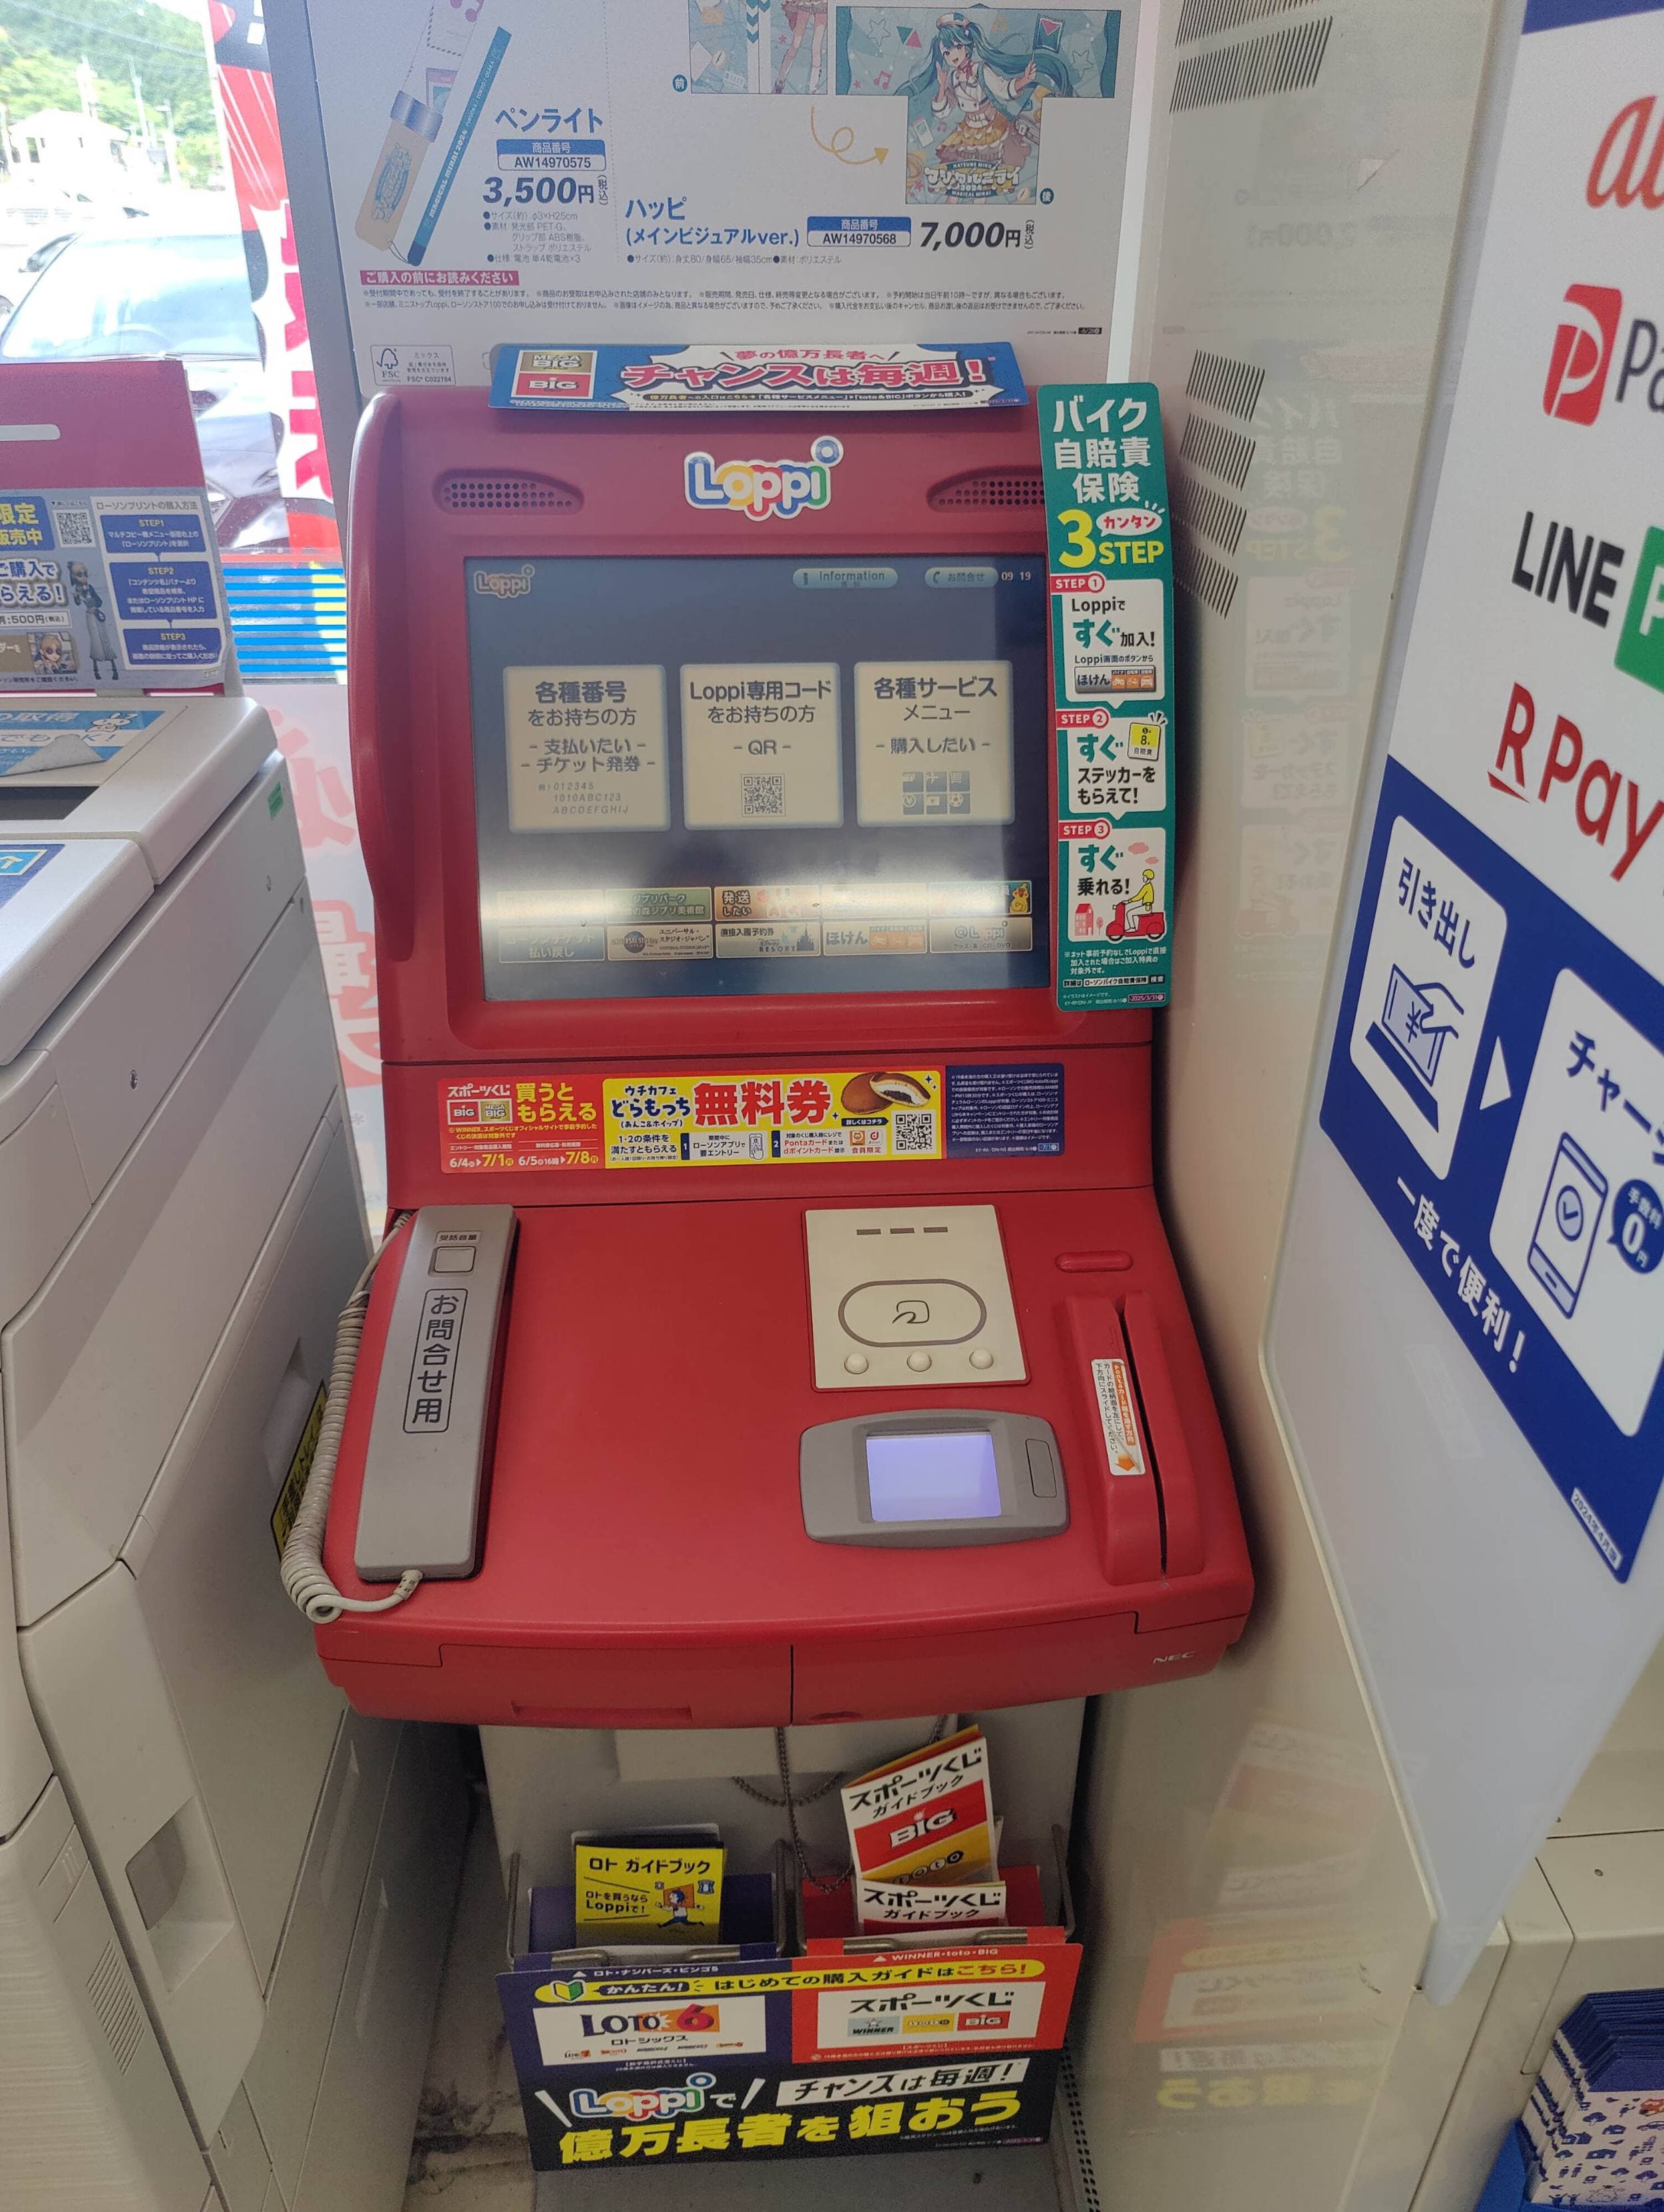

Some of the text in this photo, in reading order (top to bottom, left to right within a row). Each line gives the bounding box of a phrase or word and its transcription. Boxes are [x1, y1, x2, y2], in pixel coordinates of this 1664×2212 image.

[495, 107, 603, 133] ペンライト
[532, 142, 571, 154] 商品番号
[514, 156, 591, 168] AW14970575
[483, 176, 594, 207] 3,500円
[625, 196, 687, 220] ハッピ
[841, 219, 879, 231] 商品番号
[626, 228, 799, 248] (メインビジュアルver.)
[823, 233, 897, 246] AW14970568
[920, 222, 1021, 251] 7,000円
[366, 271, 513, 284] ご購入の前にお読みください
[736, 349, 885, 361] 夢の億万長者へ
[1053, 395, 1147, 433] バイク
[1054, 436, 1151, 470] 自賠責
[685, 436, 843, 521] Loppi
[1072, 471, 1140, 504] 保険
[97, 501, 198, 510] ローソンプリントの購入方法
[1104, 515, 1156, 530] カンタン
[819, 571, 885, 582] Information
[948, 572, 985, 582] お問合せ
[1512, 510, 1625, 628] LINE
[474, 564, 535, 600] Loppi
[1056, 580, 1085, 589] STEP
[1071, 597, 1126, 615] Loppiで
[1074, 654, 1154, 665] Loppi画面のボタンから
[873, 676, 998, 700] 各種サービス
[1077, 674, 1110, 687] ほけん
[535, 681, 627, 704] 各種番号
[689, 679, 833, 702] Loppi専用コード
[528, 707, 637, 727] をお持ちの方
[708, 705, 816, 724] をお持ちの方
[903, 705, 971, 722] メニュー
[1061, 715, 1090, 724] STEP
[1077, 733, 1124, 763] すぐ
[1078, 767, 1155, 785] ステッカーを
[554, 793, 622, 803] 1010ABC123
[1078, 788, 1138, 805] もらえて!
[552, 805, 629, 815] ABCDEFGHIJ
[1064, 826, 1092, 835] STEP
[1078, 844, 1124, 873] すぐ
[1078, 878, 1130, 896] 乗れる!
[722, 890, 751, 904] 発送
[722, 906, 752, 916] したい
[1398, 856, 1475, 969] 引き出し
[826, 931, 868, 945] ほけん
[528, 947, 575, 959] 払い戻し
[448, 1083, 511, 1097] スポーツくじ
[516, 1082, 574, 1103] 買うと
[625, 1085, 677, 1096] ウチカフェ
[611, 1097, 691, 1118] どらもっち
[694, 1079, 832, 1127] 無料券
[517, 1103, 597, 1123] もらえる
[610, 1144, 677, 1155] 満たすともらえる
[694, 1141, 746, 1149] ローソンアプリで
[1397, 1176, 1525, 1374] 一度で便利!
[412, 1294, 459, 1424] お問合せ用
[1152, 1650, 1197, 1665] NEC
[849, 1748, 982, 1811] スポーツくじ
[873, 1774, 964, 1819] ガイドブック
[589, 1856, 711, 1875] ロト ガイドブック
[586, 1891, 648, 1903] ロトを買うなら
[863, 1887, 1001, 1908] スポーツくじ
[883, 1909, 980, 1921] ガイドブック
[606, 1964, 1026, 1994] かんたん! はじめての購入ガイドはこちら!
[849, 1991, 1015, 2014] スポーツくじ
[580, 2013, 661, 2038] LOTO
[851, 2026, 894, 2036] WINNER
[611, 2035, 689, 2046] ロトシックス
[795, 2062, 1014, 2102] チャンスは毎週!
[558, 2090, 1022, 2164] 億万長者を狙おう
